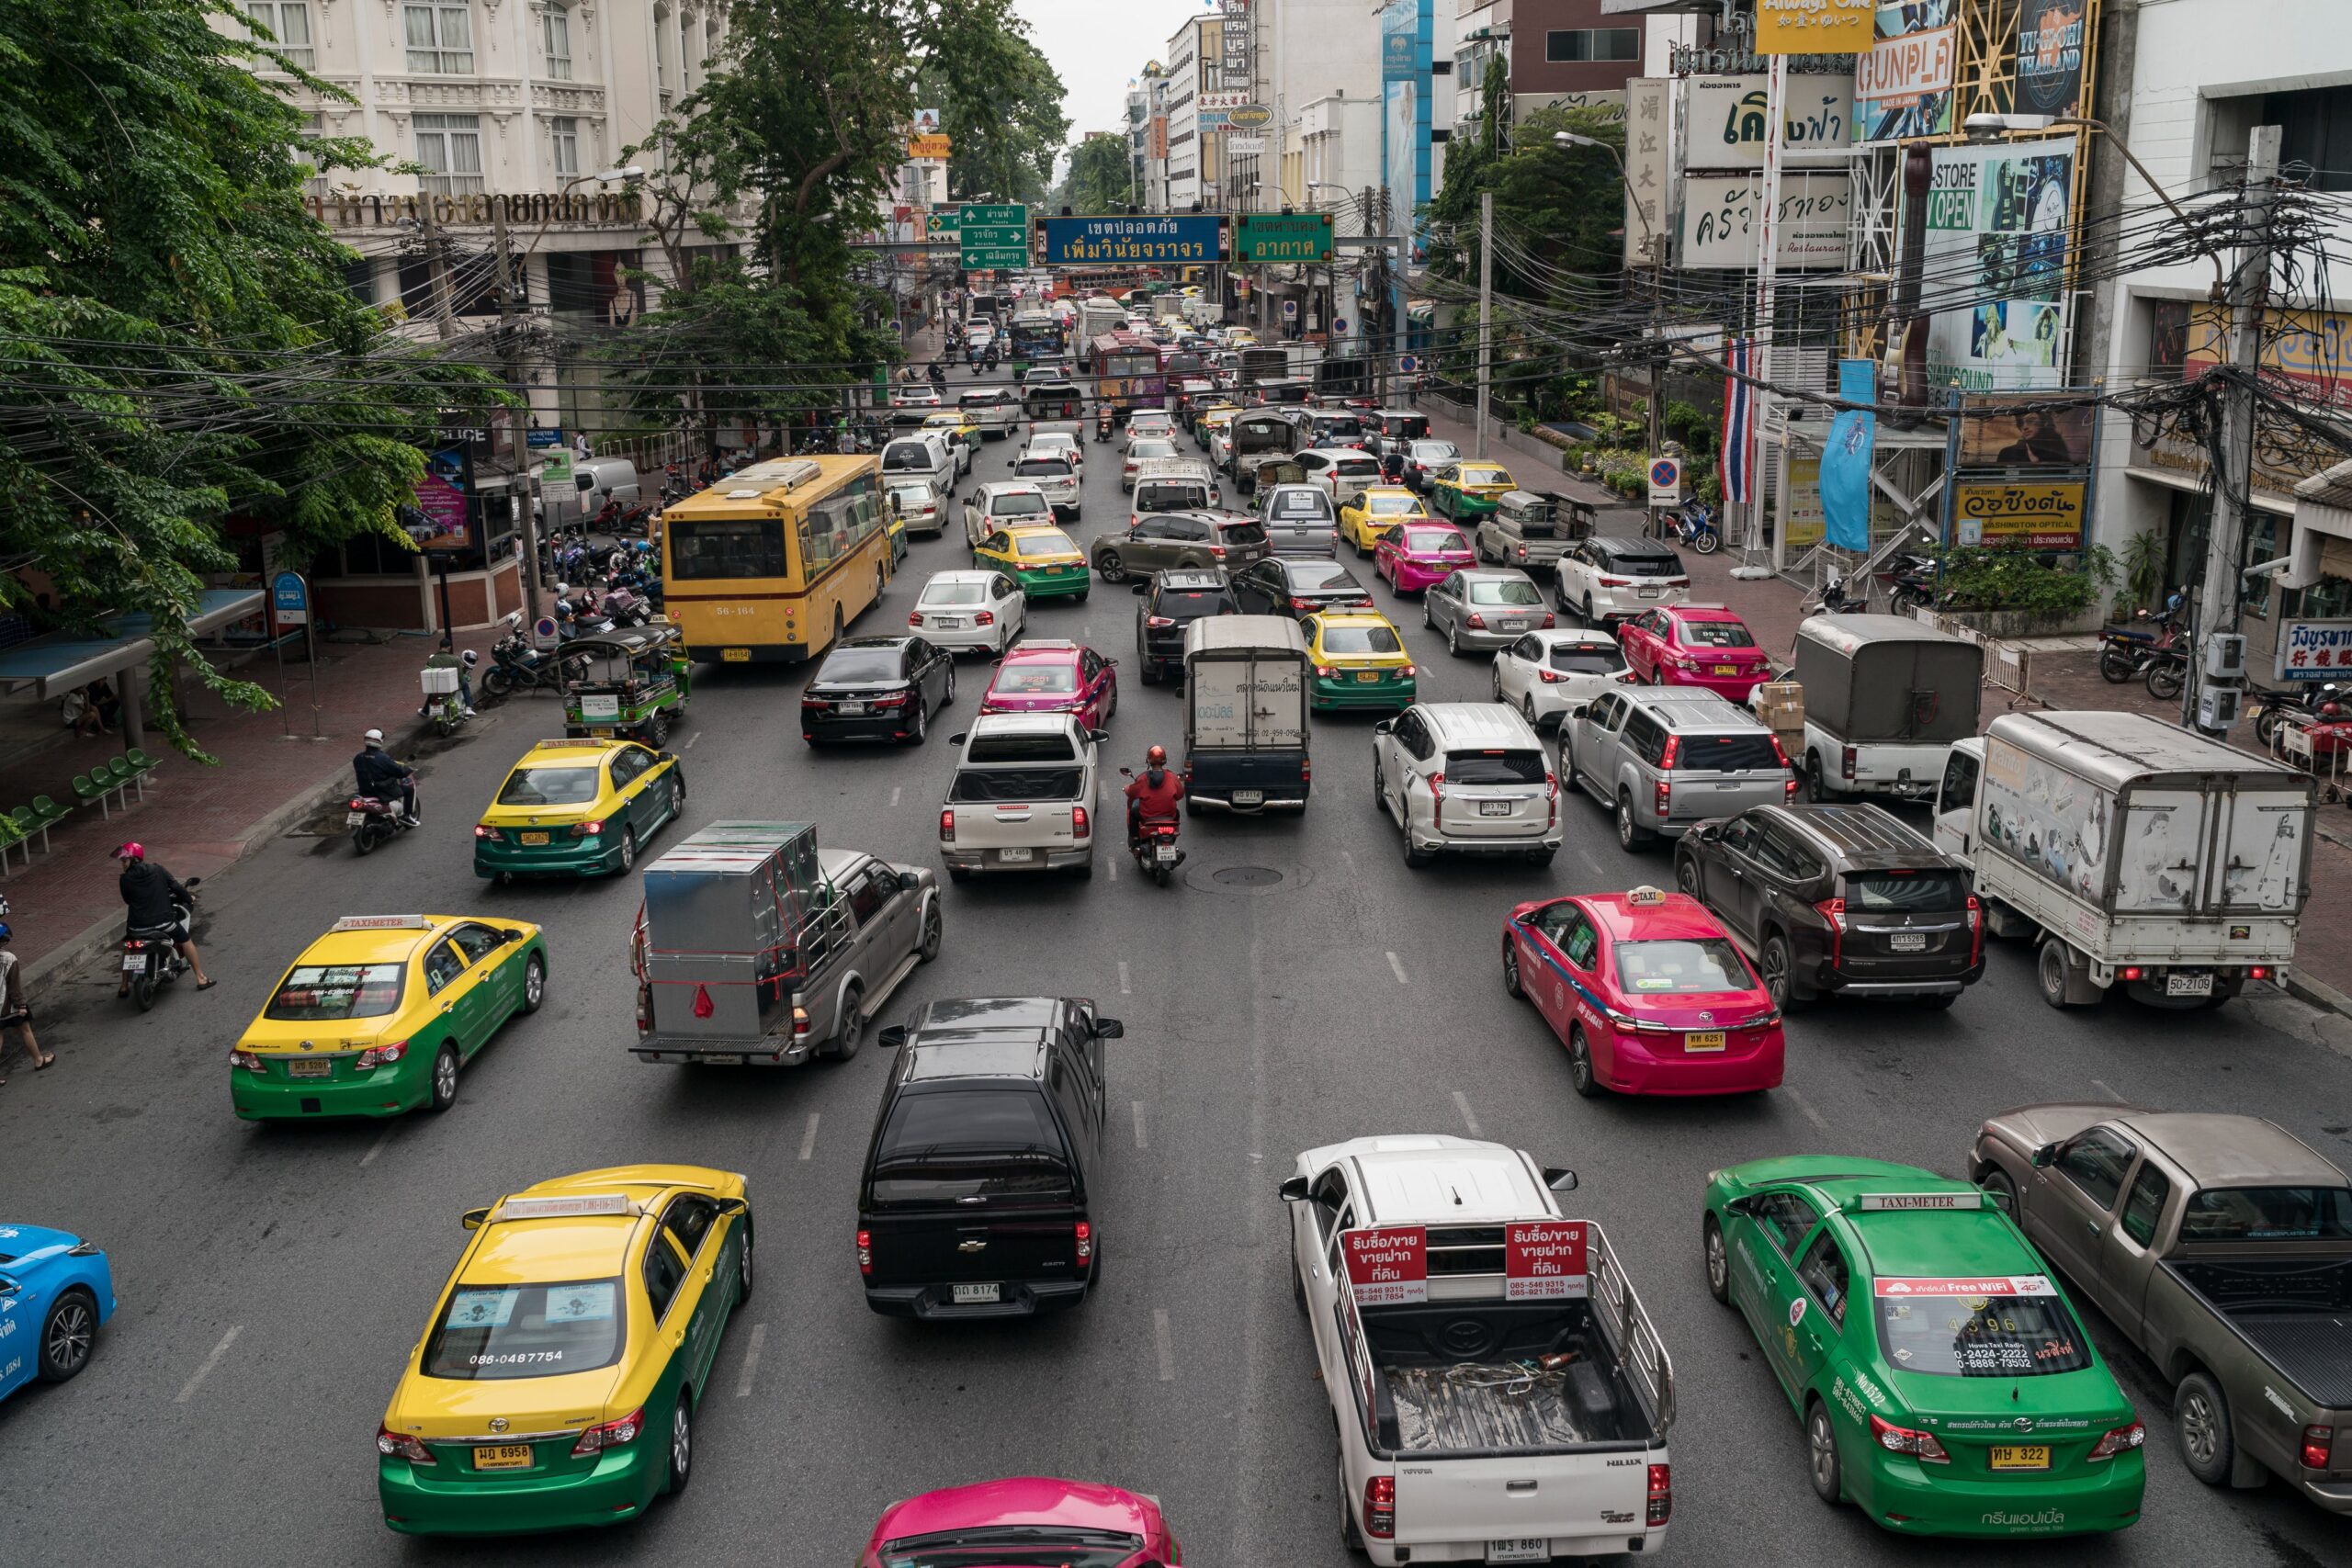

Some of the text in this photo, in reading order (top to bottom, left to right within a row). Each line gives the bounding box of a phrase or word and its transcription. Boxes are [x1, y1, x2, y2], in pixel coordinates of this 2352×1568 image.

[1858, 37, 1949, 93] GUNPLA
[2018, 49, 2080, 77] THAILAND
[1699, 80, 1741, 90] ห้องอาหาร
[1902, 96, 1917, 105] JAPAN
[1936, 191, 1973, 228] OPEN
[1088, 218, 1178, 235] เขตปลอดภัย
[1063, 236, 1204, 259] เพิ่มวินัยจราจร
[1256, 240, 1314, 256] อากาศ
[1984, 521, 2036, 530] WASHINGTON
[1639, 892, 1657, 900] TAXI
[2170, 978, 2211, 989] 50-2109
[1704, 1033, 1723, 1042] 6251
[1880, 1197, 1955, 1209] TAXI-METER
[1353, 1231, 1418, 1250] รับซื้อ/ขาย
[1512, 1224, 1578, 1244] รับซื้อ/ขาย
[1360, 1248, 1411, 1264] ขายฝาก
[1521, 1243, 1572, 1258] ขายฝาก
[1372, 1264, 1400, 1281] ที่ดิน
[1532, 1258, 1561, 1275] ที่ดิน
[973, 1284, 998, 1294] 8174
[1385, 1286, 1404, 1294] 9315
[1510, 1289, 1544, 1297] 085-921
[1949, 1282, 1975, 1292] Free
[1979, 1281, 2008, 1292] WiFi
[1954, 1349, 2029, 1359] 0-2424-2222
[6, 1355, 21, 1377] 1584
[1957, 1359, 2032, 1369] 0-8888-73502
[1855, 1373, 1886, 1408] No.3522
[501, 1446, 528, 1458] 6958
[2020, 1448, 2044, 1461] 322
[1982, 1507, 2064, 1525] กรีนแอปเปิ้ล
[1521, 1539, 1543, 1550] 860
